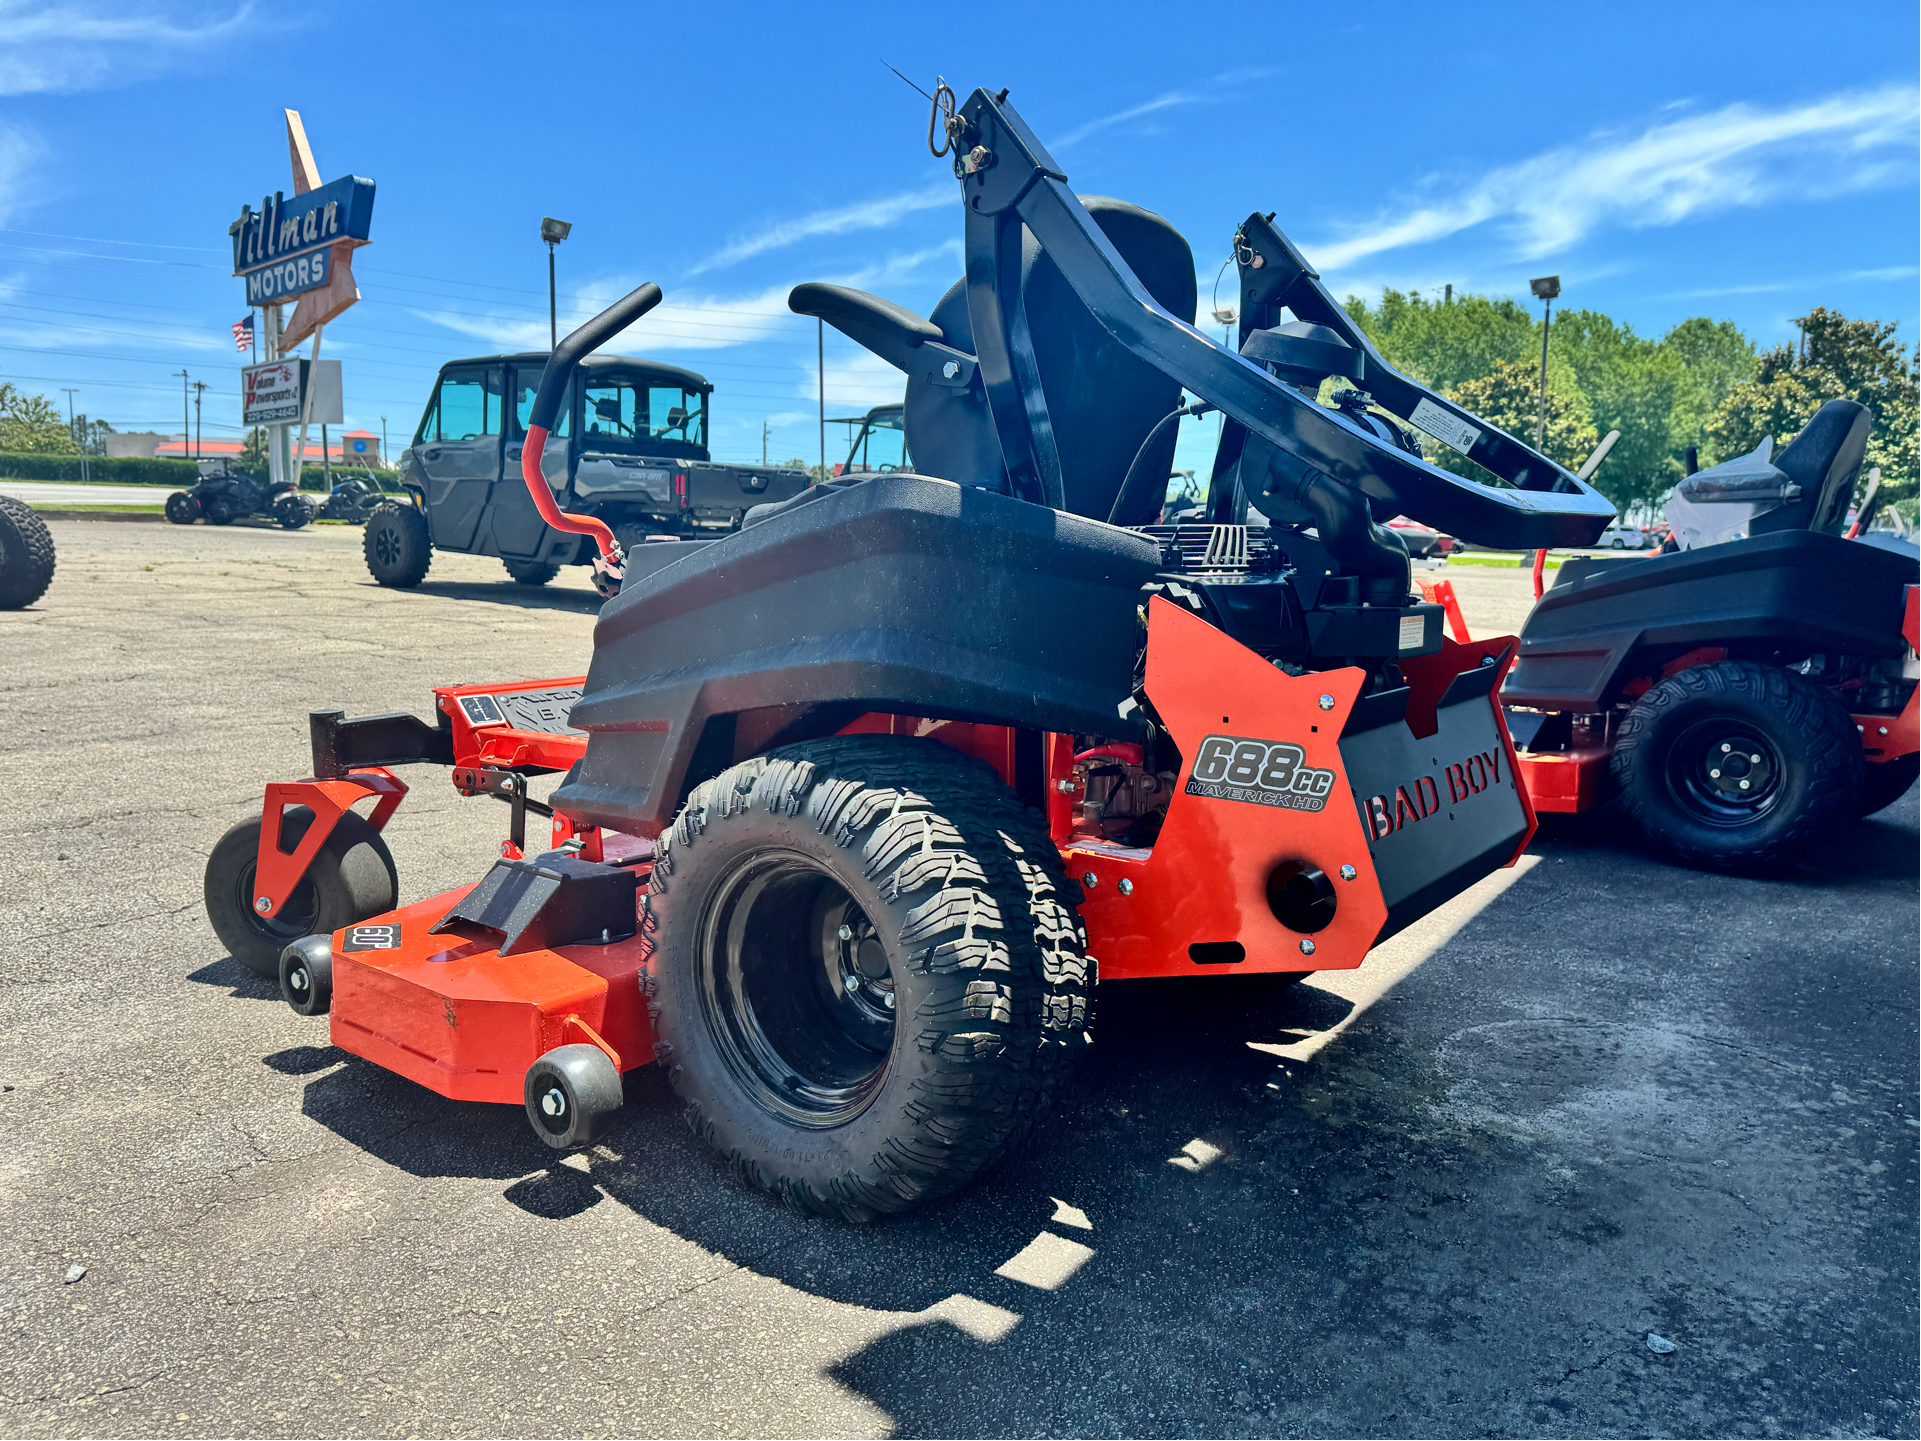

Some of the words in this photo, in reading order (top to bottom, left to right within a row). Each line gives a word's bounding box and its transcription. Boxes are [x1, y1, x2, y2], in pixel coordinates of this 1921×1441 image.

[229, 191, 338, 267] Tillman
[249, 253, 324, 302] MOTORS
[244, 389, 291, 411] Powersports
[245, 371, 275, 391] Volume
[1186, 781, 1291, 807] MAVERICK
[1292, 796, 1324, 811] HD
[1363, 775, 1440, 842] BAD
[1445, 747, 1500, 805] BOY
